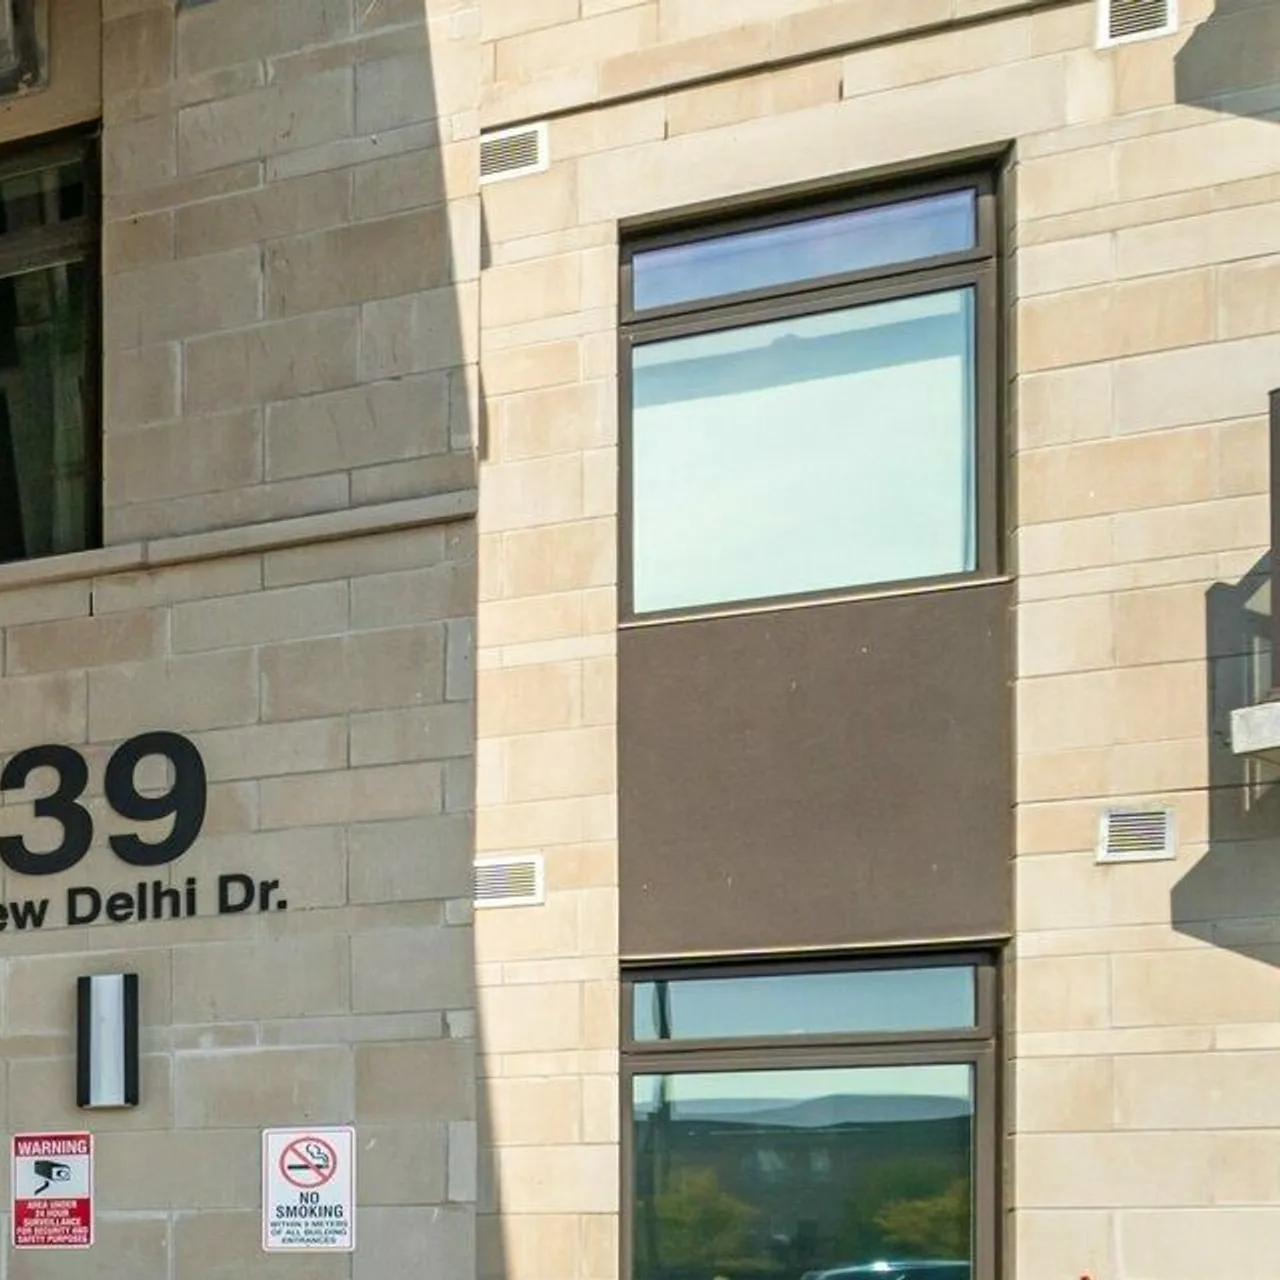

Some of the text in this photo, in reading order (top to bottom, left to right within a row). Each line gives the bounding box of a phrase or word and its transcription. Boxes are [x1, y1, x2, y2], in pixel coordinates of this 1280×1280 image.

[66, 877, 197, 927] Delhi
[218, 873, 288, 914] Dr.
[18, 1140, 88, 1155] WARNING
[299, 1191, 320, 1205] NO
[276, 1204, 344, 1219] SMOKING
